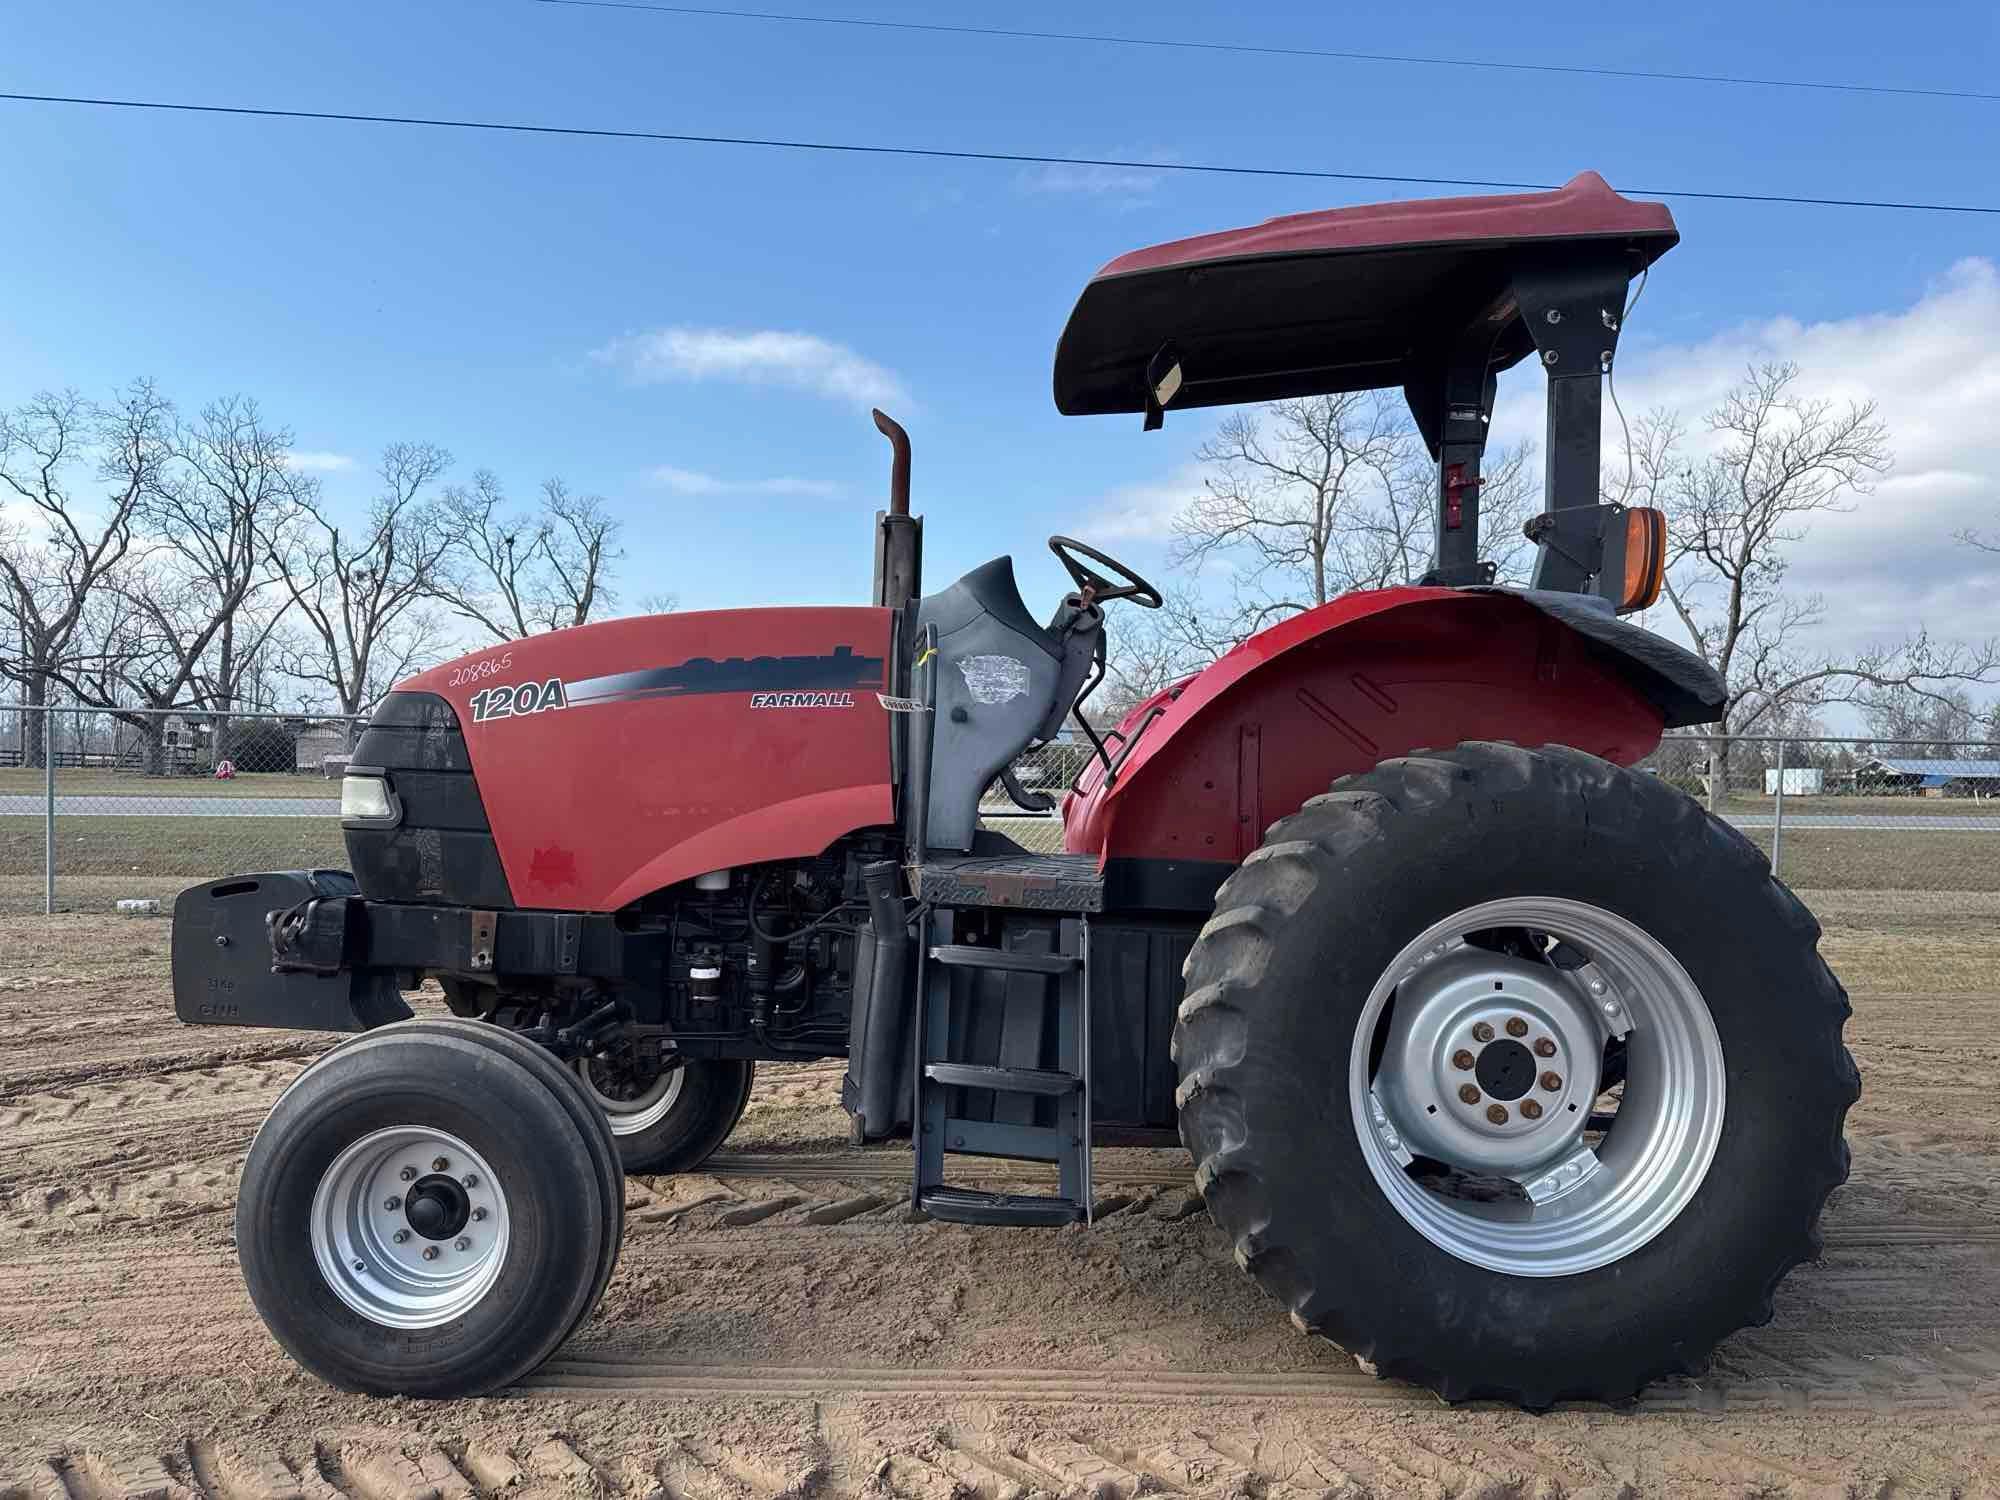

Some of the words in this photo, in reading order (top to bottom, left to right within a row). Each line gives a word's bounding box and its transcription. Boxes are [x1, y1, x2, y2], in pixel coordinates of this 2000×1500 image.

[448, 652, 512, 687] 208865
[469, 678, 566, 722] 120A
[750, 692, 855, 709] FARMALL
